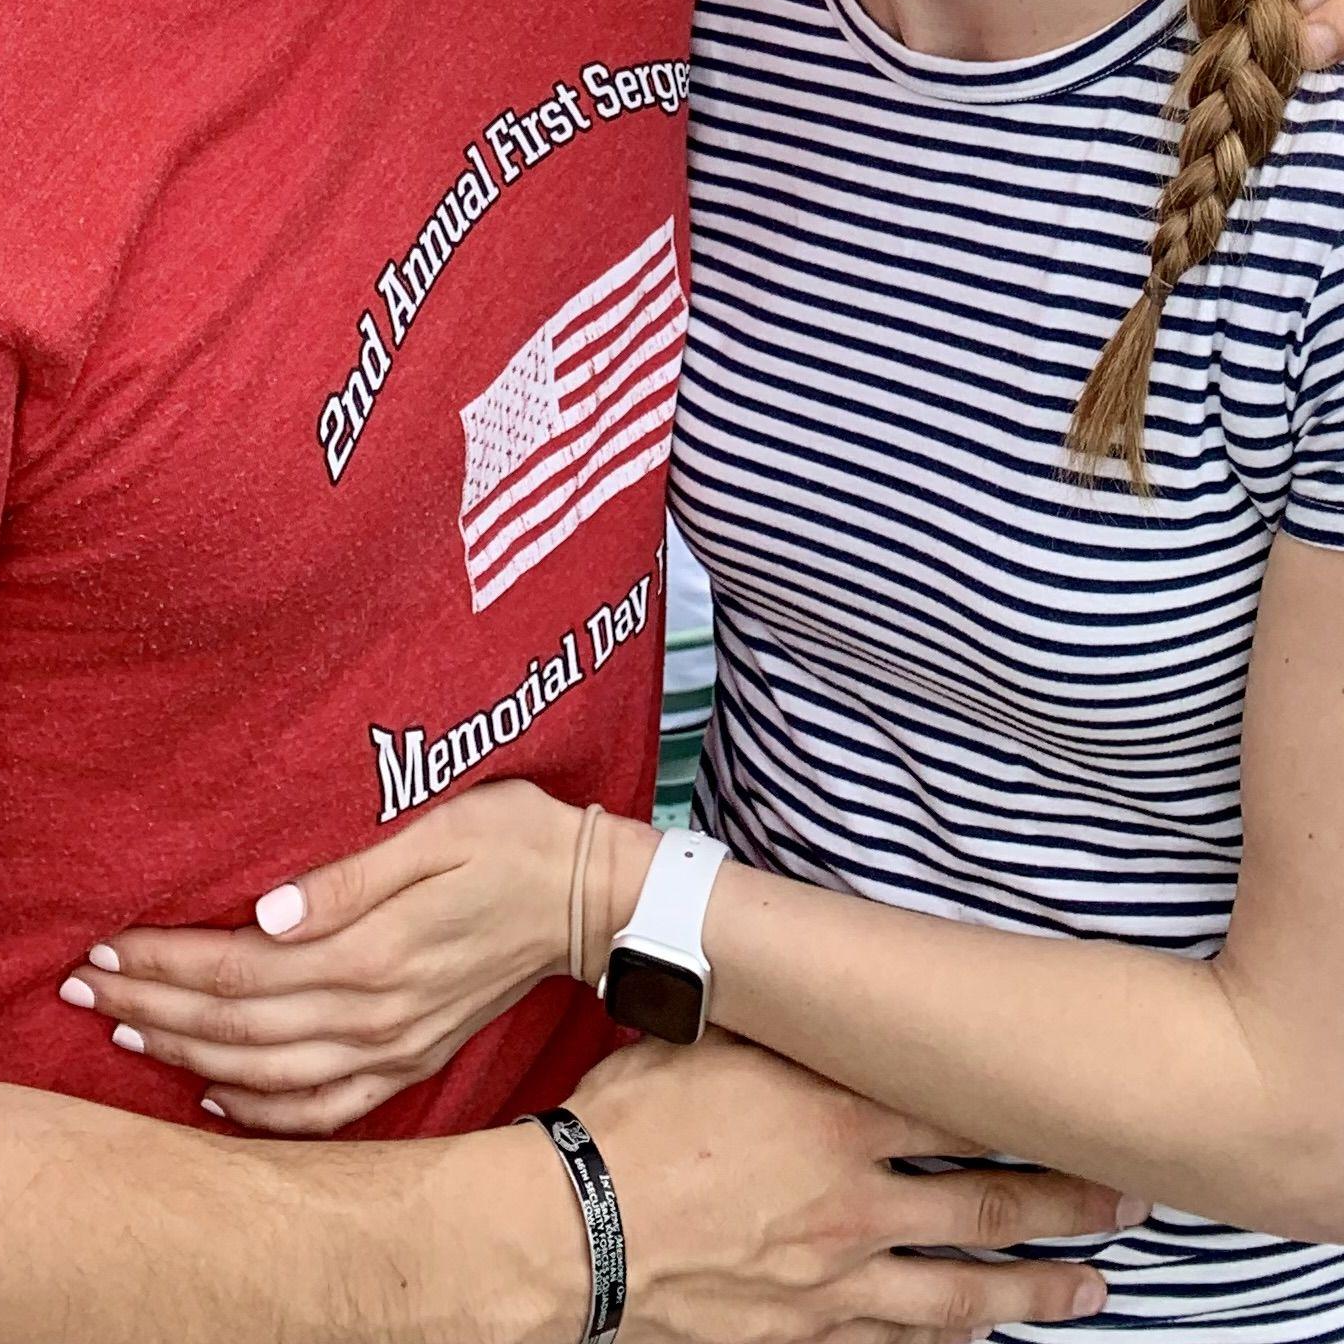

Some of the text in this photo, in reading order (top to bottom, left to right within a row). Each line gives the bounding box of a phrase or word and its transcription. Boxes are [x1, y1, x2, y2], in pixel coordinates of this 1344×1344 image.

[318, 310, 392, 485] 2nd
[375, 141, 503, 349] Annual
[483, 79, 593, 186] First
[369, 572, 653, 825] Memorial Day
[584, 1181, 605, 1230] SECURITY
